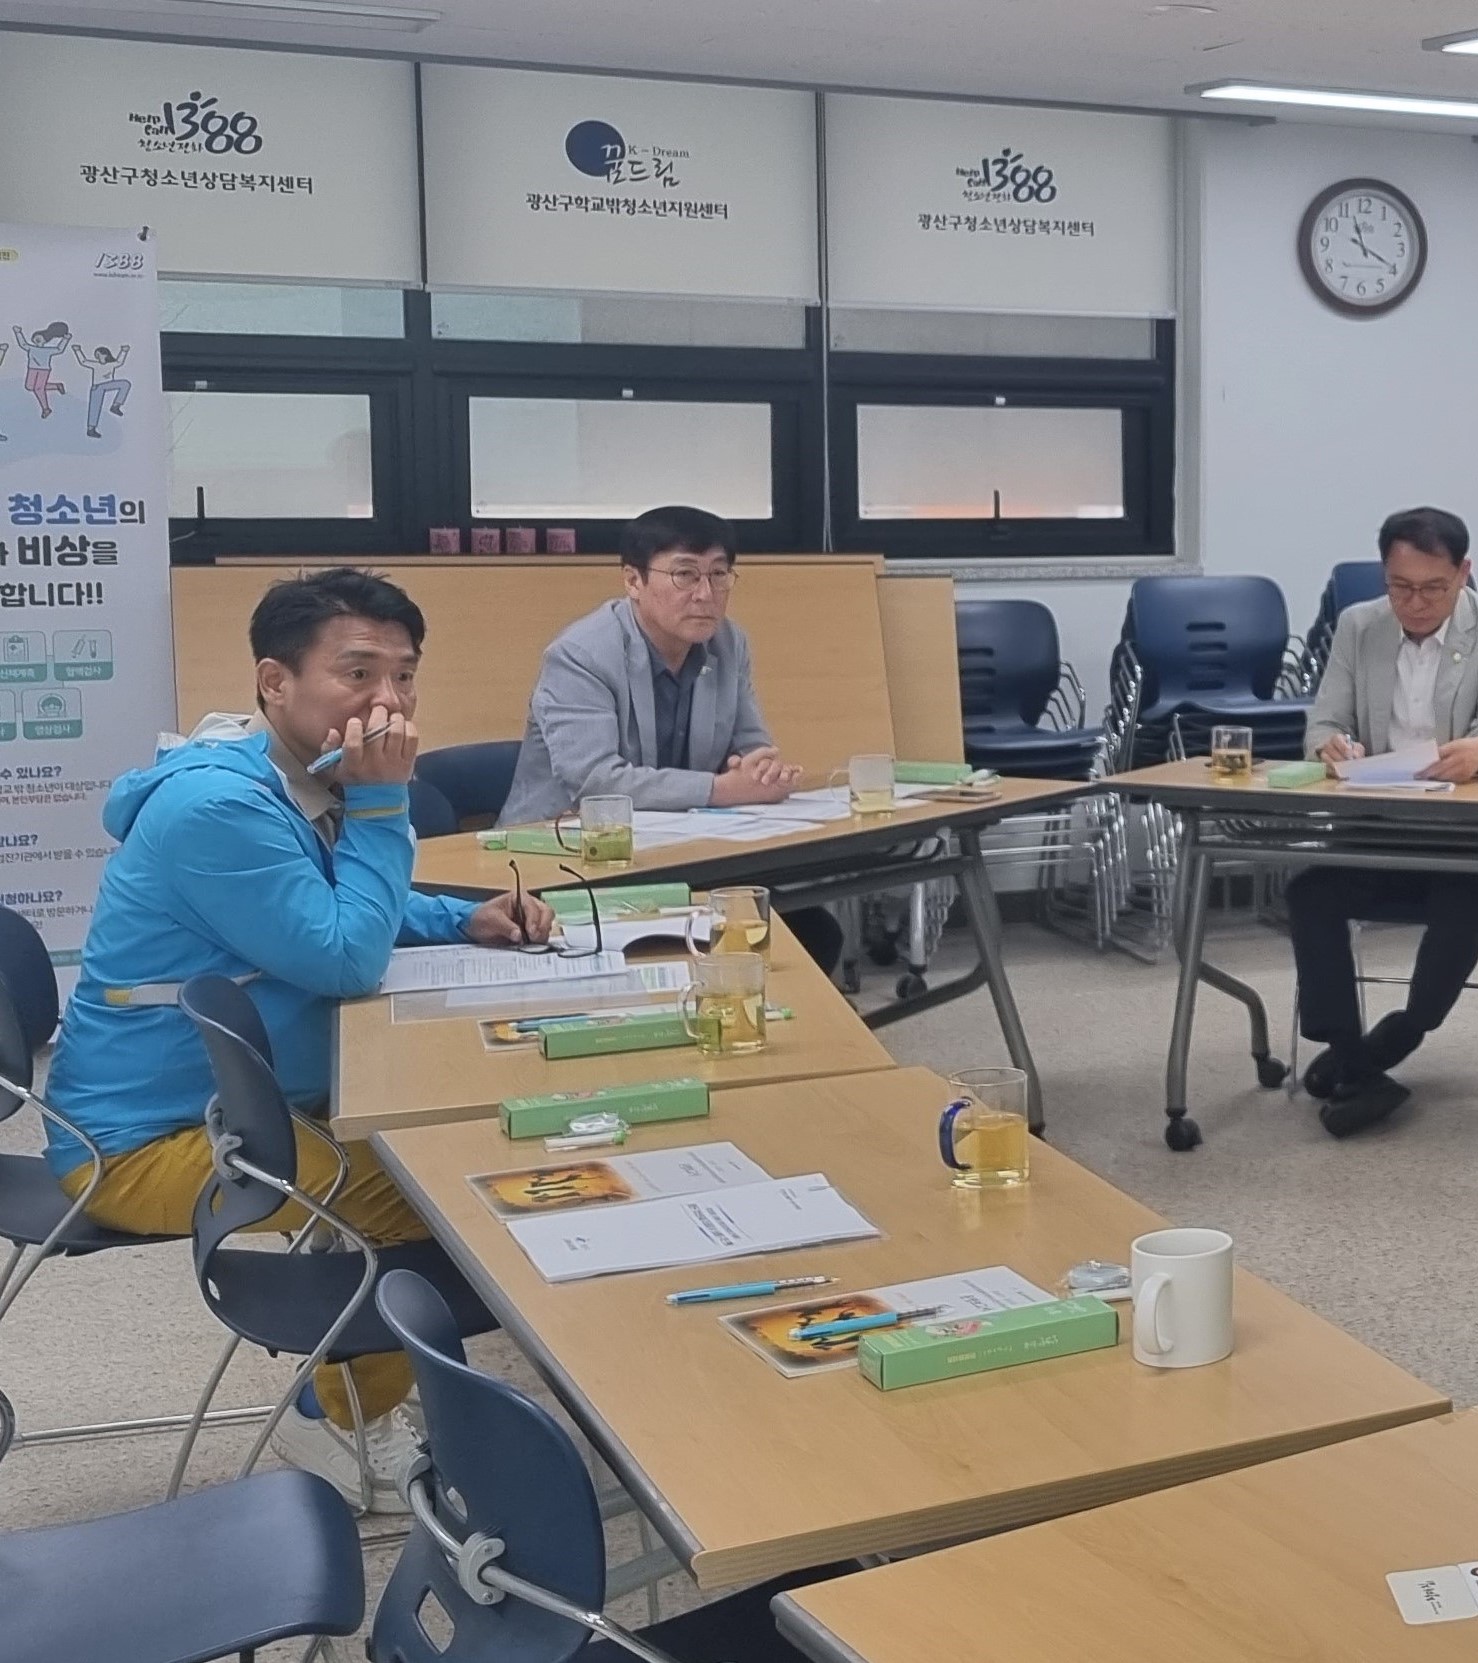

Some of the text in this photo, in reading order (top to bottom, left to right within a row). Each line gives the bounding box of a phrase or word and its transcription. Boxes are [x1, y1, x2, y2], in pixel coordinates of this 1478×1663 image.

[129, 112, 161, 124] Help
[163, 91, 262, 154] 1388
[600, 144, 680, 188] 꿈드림
[80, 164, 313, 194] 광산구청소년상담복지센터
[982, 147, 1057, 203] 1388
[526, 192, 728, 219] 광산구학교밖청소년지원센터
[1339, 202, 1350, 218] 11
[1358, 198, 1373, 214] 12
[1381, 206, 1387, 220] 1
[917, 213, 1094, 237] 광산구청소년상담복지센터
[1324, 217, 1339, 233] 10
[1393, 222, 1402, 237] 2
[1320, 237, 1330, 252] 9
[1396, 242, 1405, 257] 3
[1325, 259, 1334, 273] 8
[1388, 263, 1398, 276] 4
[1340, 276, 1348, 291] 7
[1356, 281, 1366, 296] 6
[1376, 278, 1385, 293] 5
[8, 493, 146, 525] 청소년의
[18, 535, 118, 566] 비상을
[0, 582, 103, 607] 합니다!!
[0, 765, 62, 780] 수 있나요?
[0, 889, 62, 905] 청하나요?
